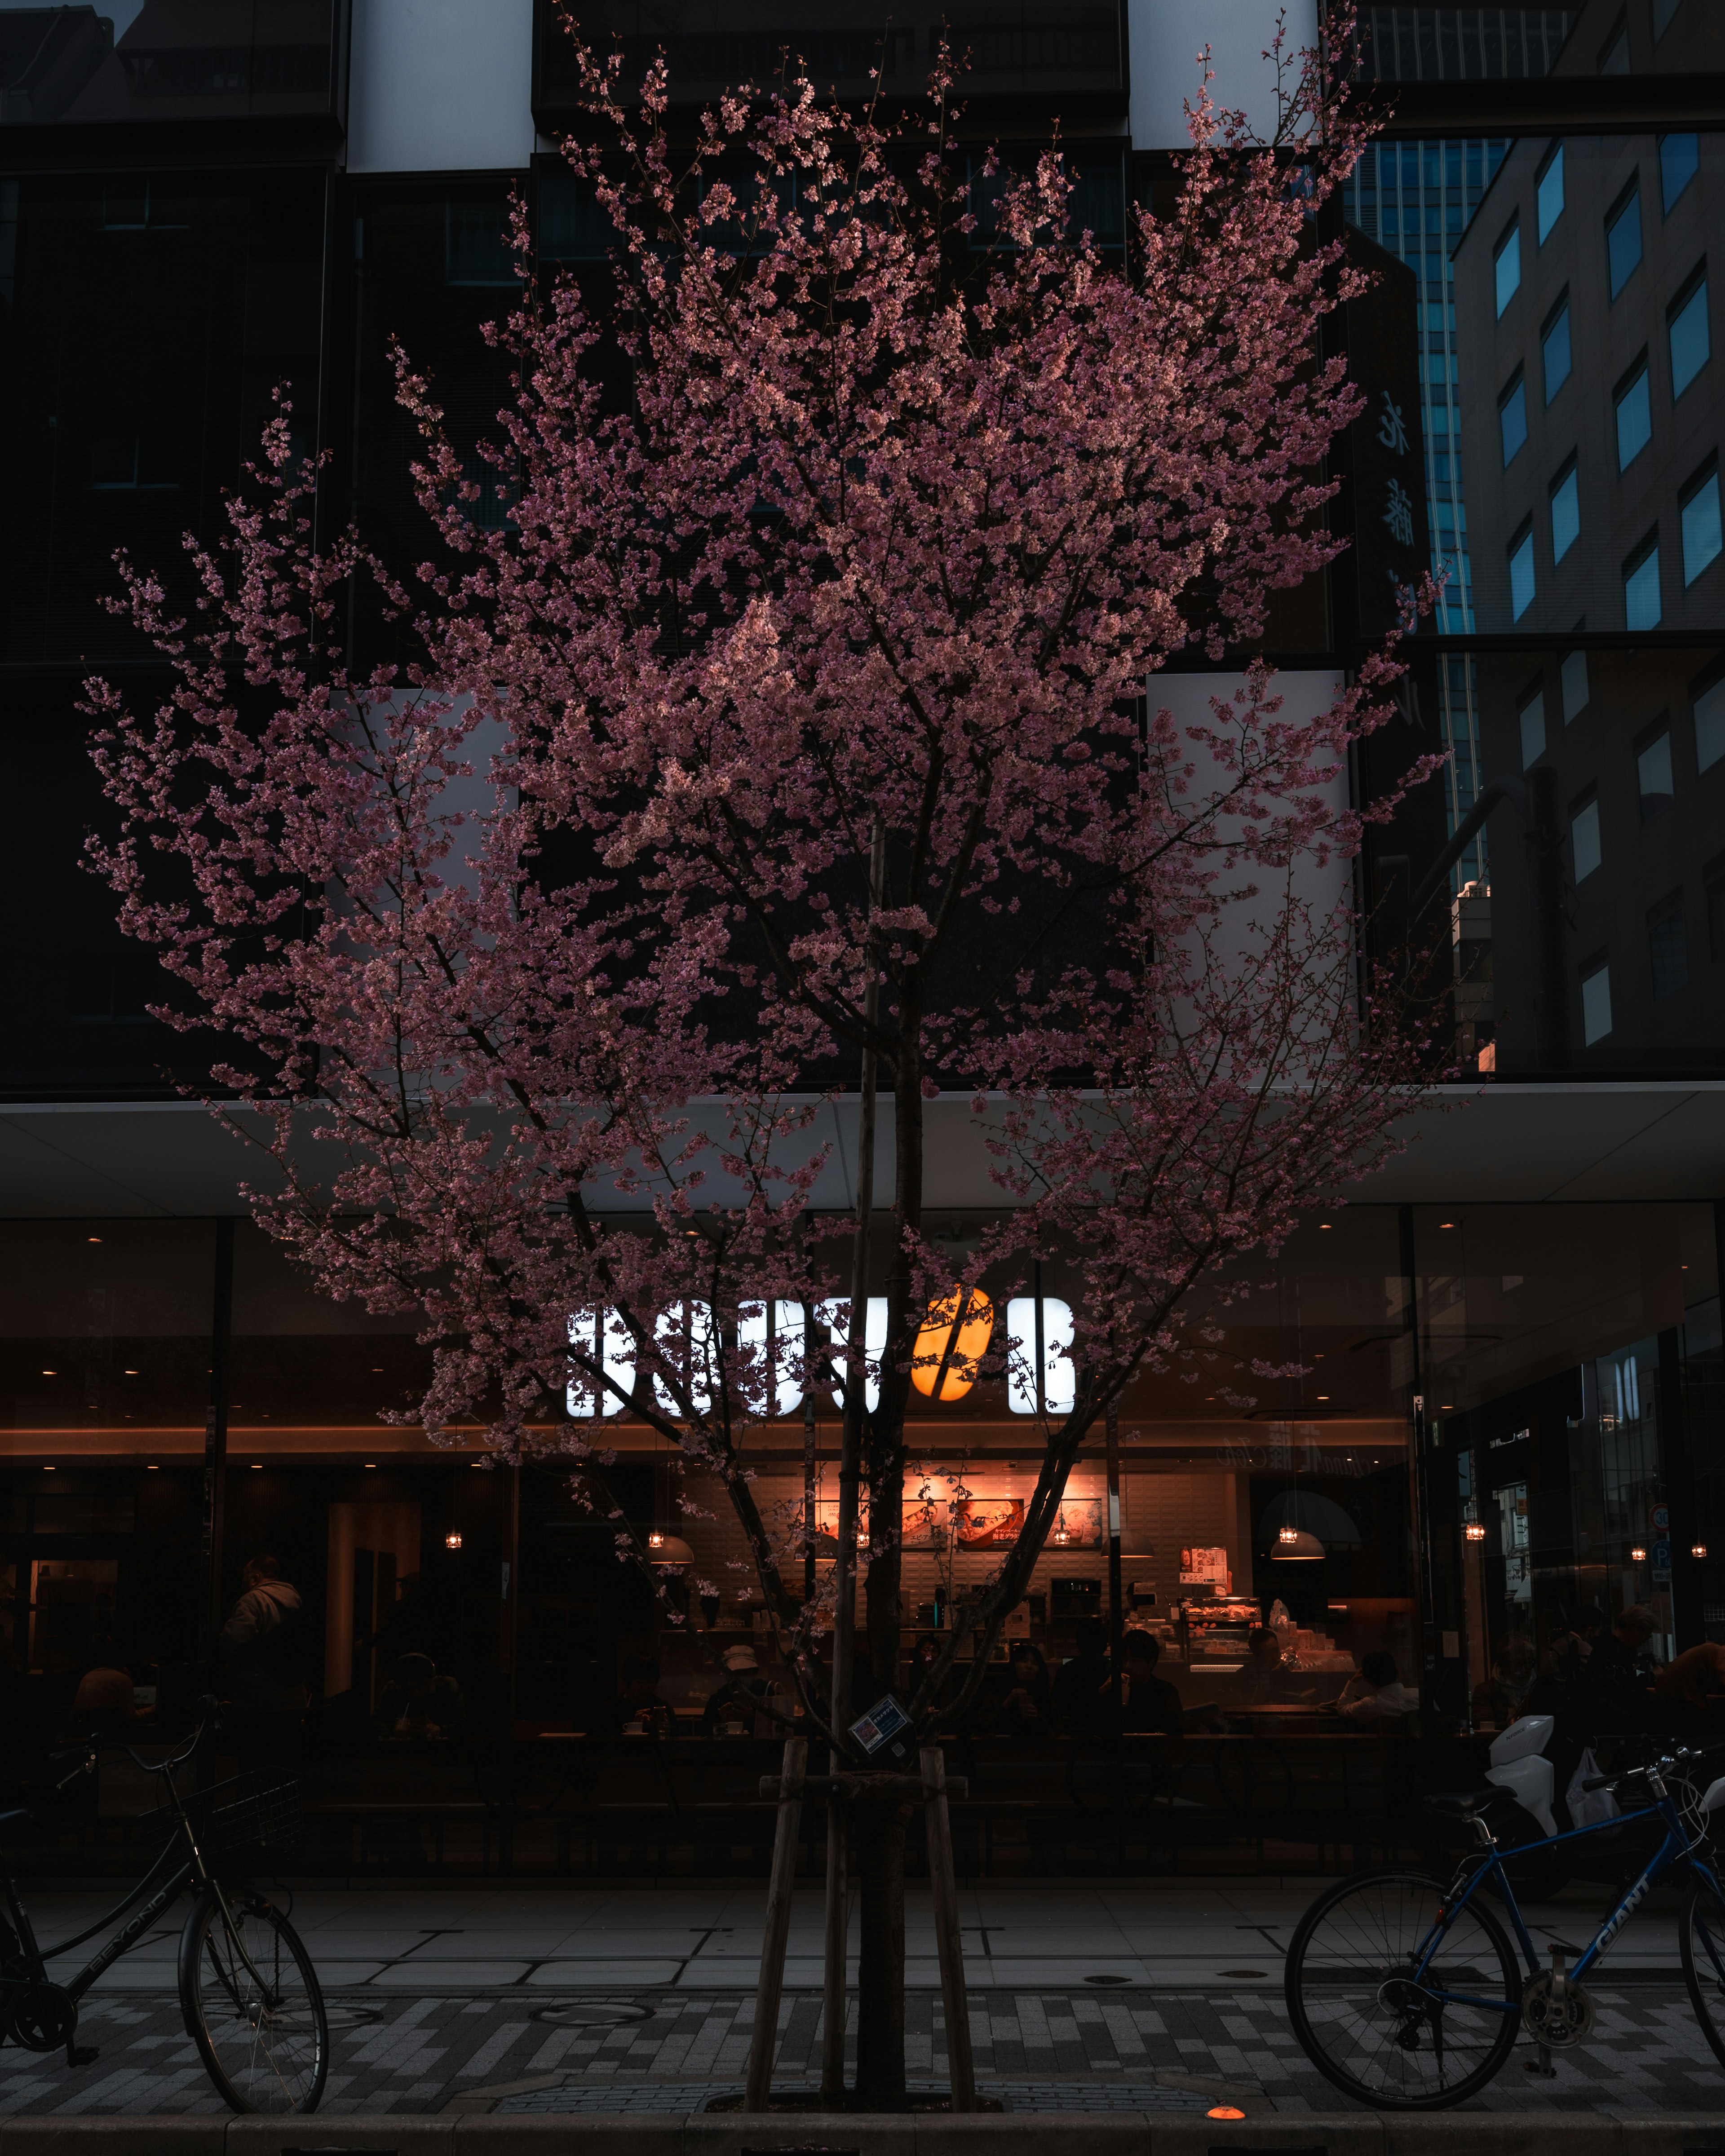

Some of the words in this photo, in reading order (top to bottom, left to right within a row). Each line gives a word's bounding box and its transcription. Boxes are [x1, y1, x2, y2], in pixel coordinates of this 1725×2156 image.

[1656, 1512, 1669, 1524] 30
[1657, 1548, 1667, 1566] P
[873, 1705, 893, 1724] オカメサクラ
[1596, 1873, 1651, 1954] GIANT
[89, 1891, 167, 1973] BEYOND
